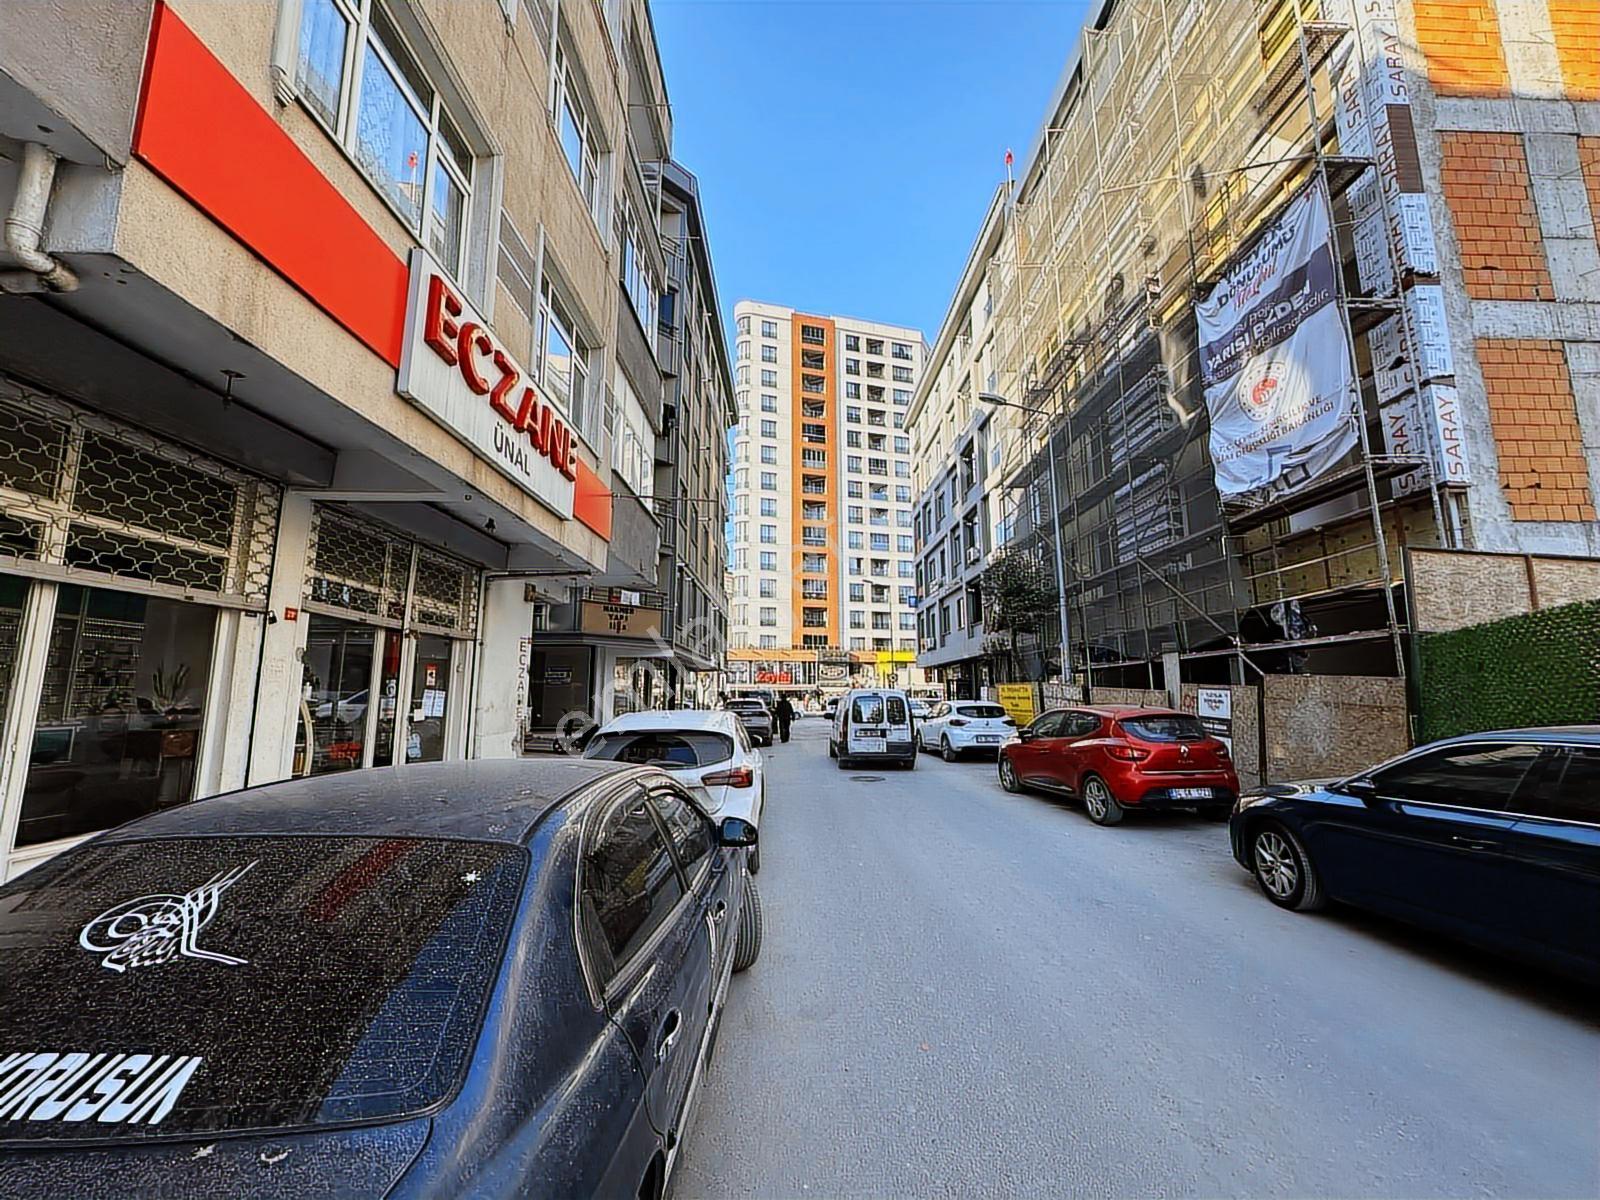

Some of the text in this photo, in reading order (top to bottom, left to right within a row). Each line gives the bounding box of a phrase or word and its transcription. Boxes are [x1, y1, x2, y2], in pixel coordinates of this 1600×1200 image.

[1380, 31, 1407, 97] SARAY
[1341, 71, 1363, 129] SARA
[424, 274, 578, 483] ECZANE
[1206, 332, 1250, 373] YARISI
[494, 424, 531, 477] ÜNAL
[1389, 415, 1416, 490] SRAY
[1439, 396, 1465, 478] SARAY
[515, 640, 528, 718] ECZAE
